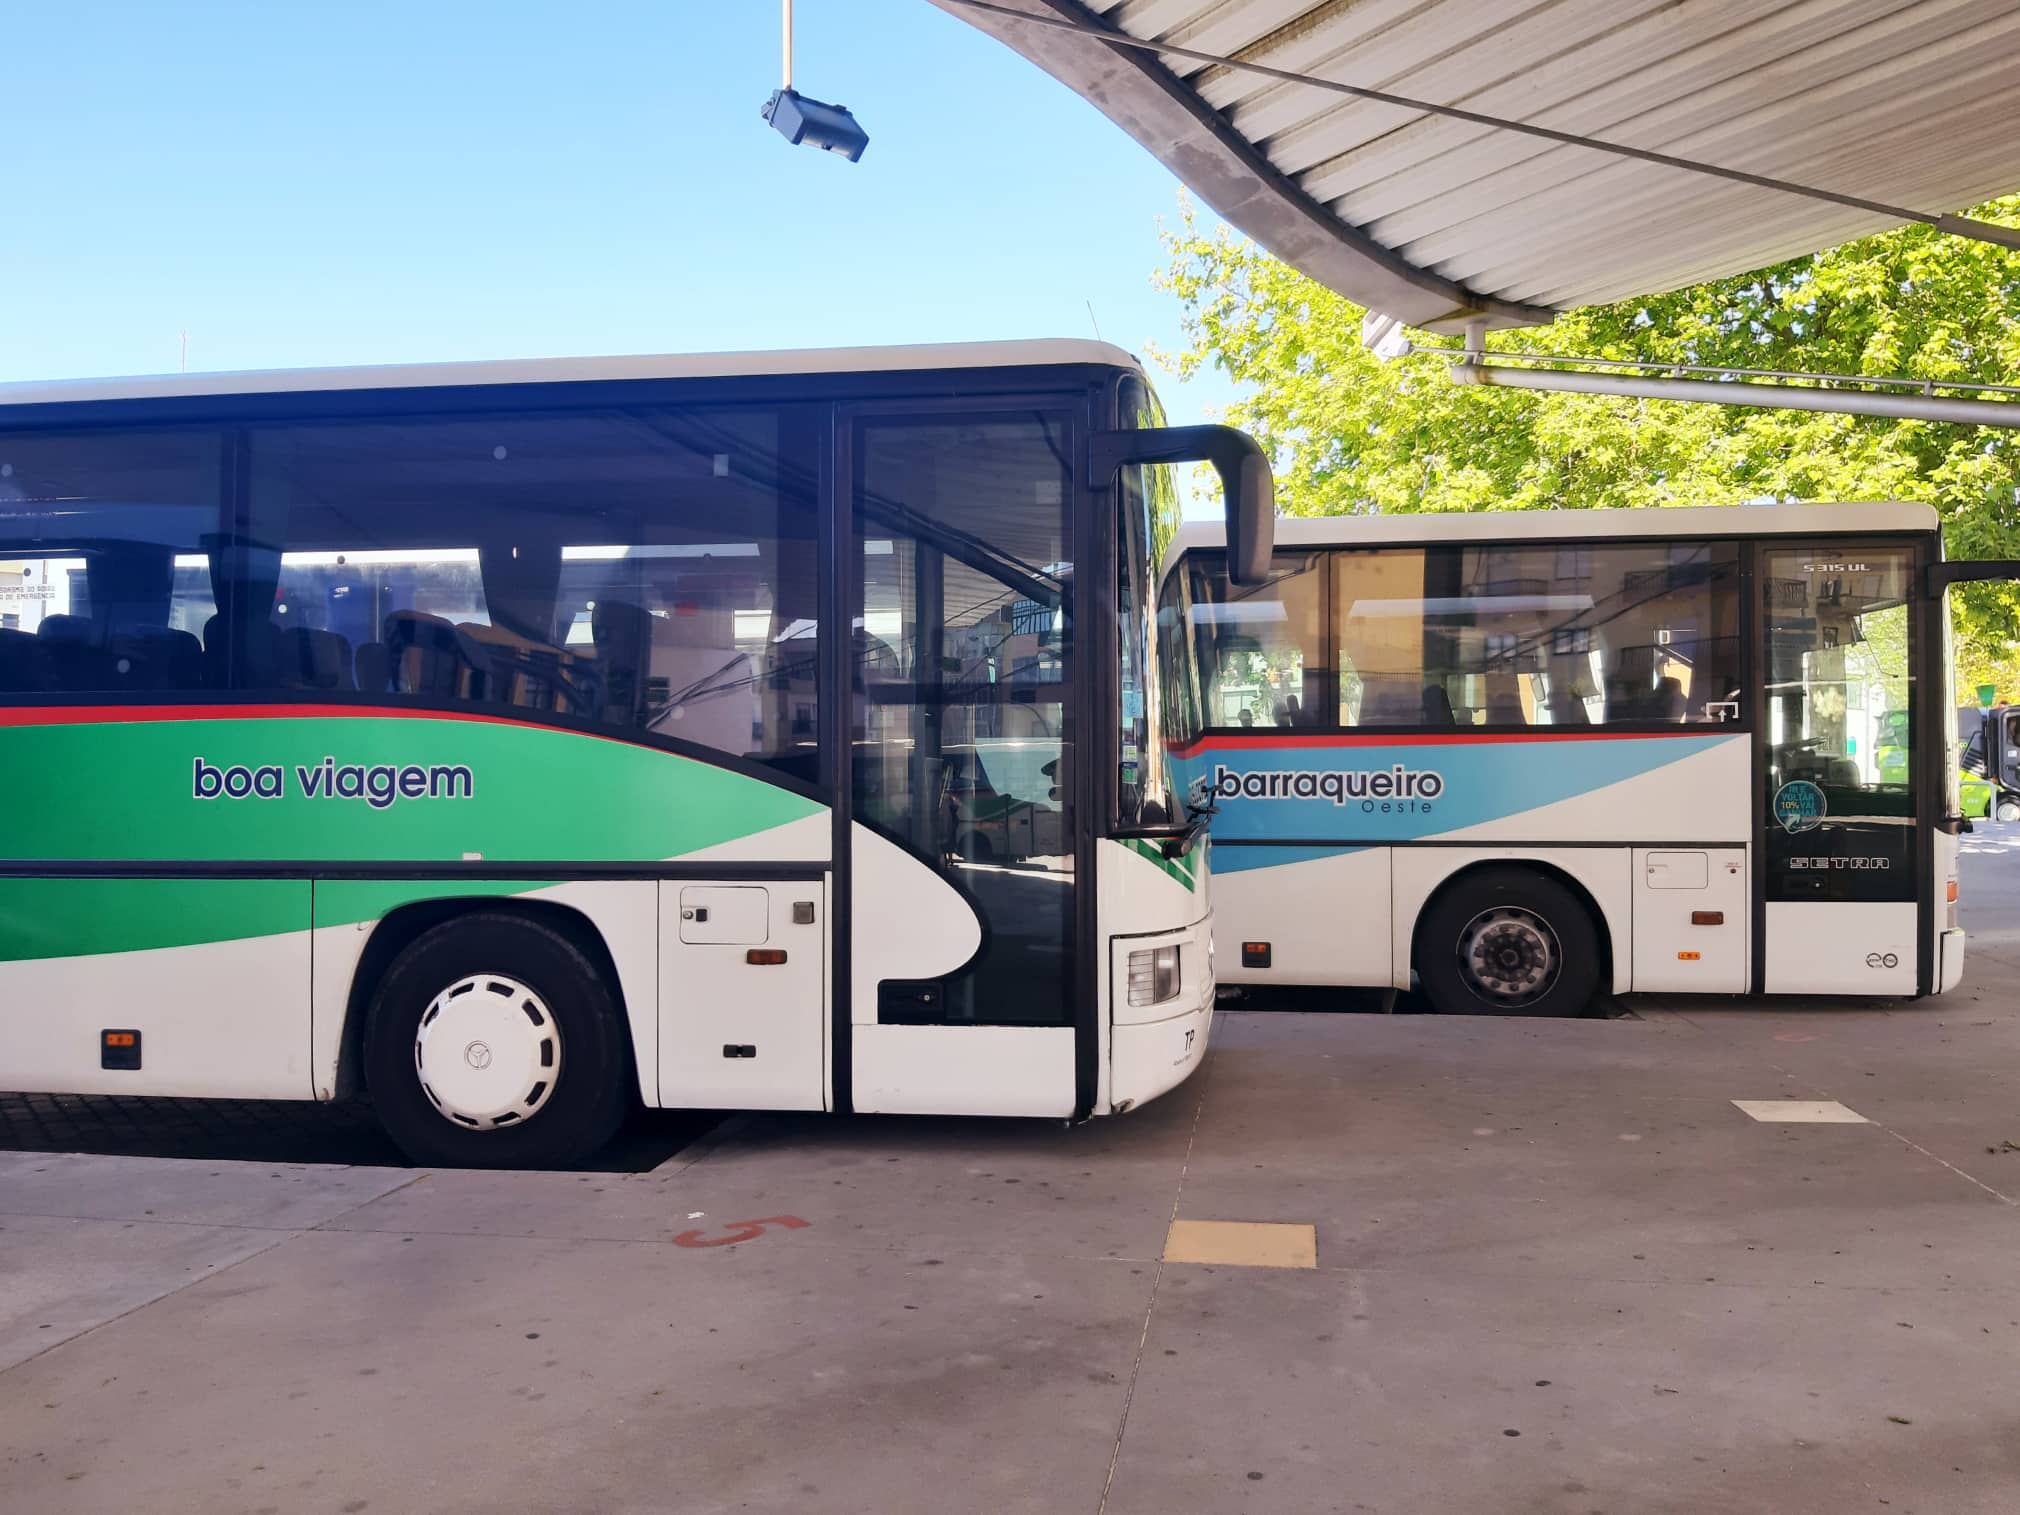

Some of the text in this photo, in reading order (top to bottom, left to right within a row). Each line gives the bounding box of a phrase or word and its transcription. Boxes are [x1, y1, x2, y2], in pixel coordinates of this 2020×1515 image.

[1848, 563, 1872, 573] UL
[193, 756, 474, 809] boa viagem
[1215, 764, 1444, 806] barraqueiro
[1361, 799, 1432, 814] Oeste
[1781, 801, 1799, 809] 10%
[1790, 857, 1890, 869] SETRA
[1185, 1029, 1195, 1051] TP
